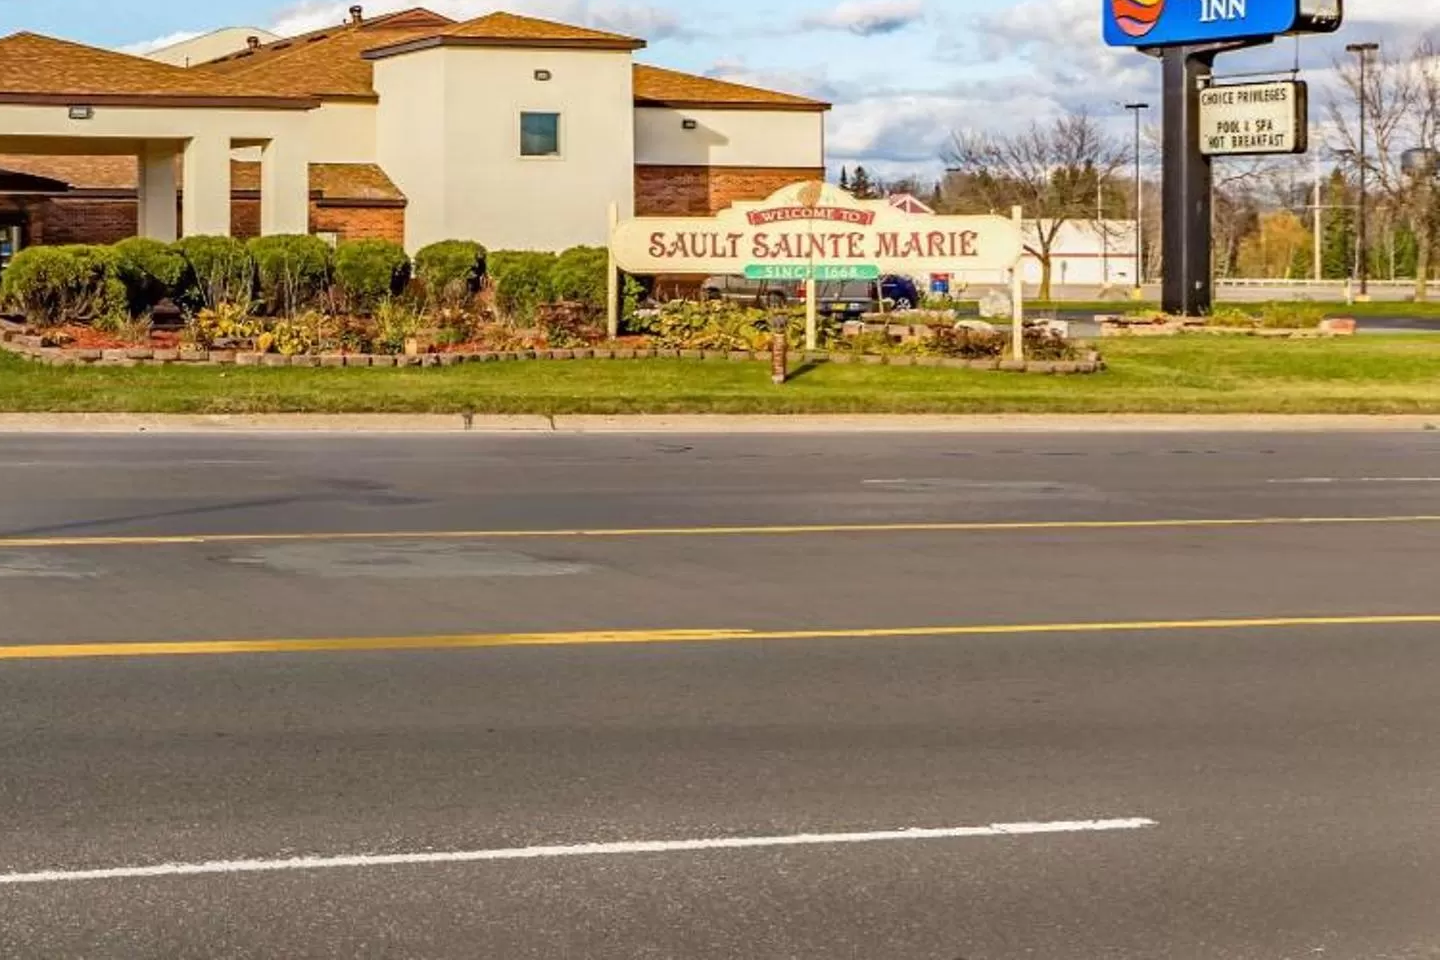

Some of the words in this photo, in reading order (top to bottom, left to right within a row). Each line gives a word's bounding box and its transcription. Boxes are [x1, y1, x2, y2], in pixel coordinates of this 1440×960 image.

[1202, 92, 1234, 106] CHOICE
[1237, 88, 1287, 103] PRIVILEGES
[1217, 121, 1240, 133] POOL
[1255, 120, 1273, 132] SPA
[1208, 135, 1225, 149] HOT
[1232, 134, 1284, 148] BREAKFAST
[762, 208, 833, 222] WELCOME
[840, 211, 860, 221] TO
[648, 231, 744, 258] SAULT
[752, 231, 866, 258] SAINTE
[875, 230, 979, 258] MARIE
[825, 266, 857, 278] 1668
